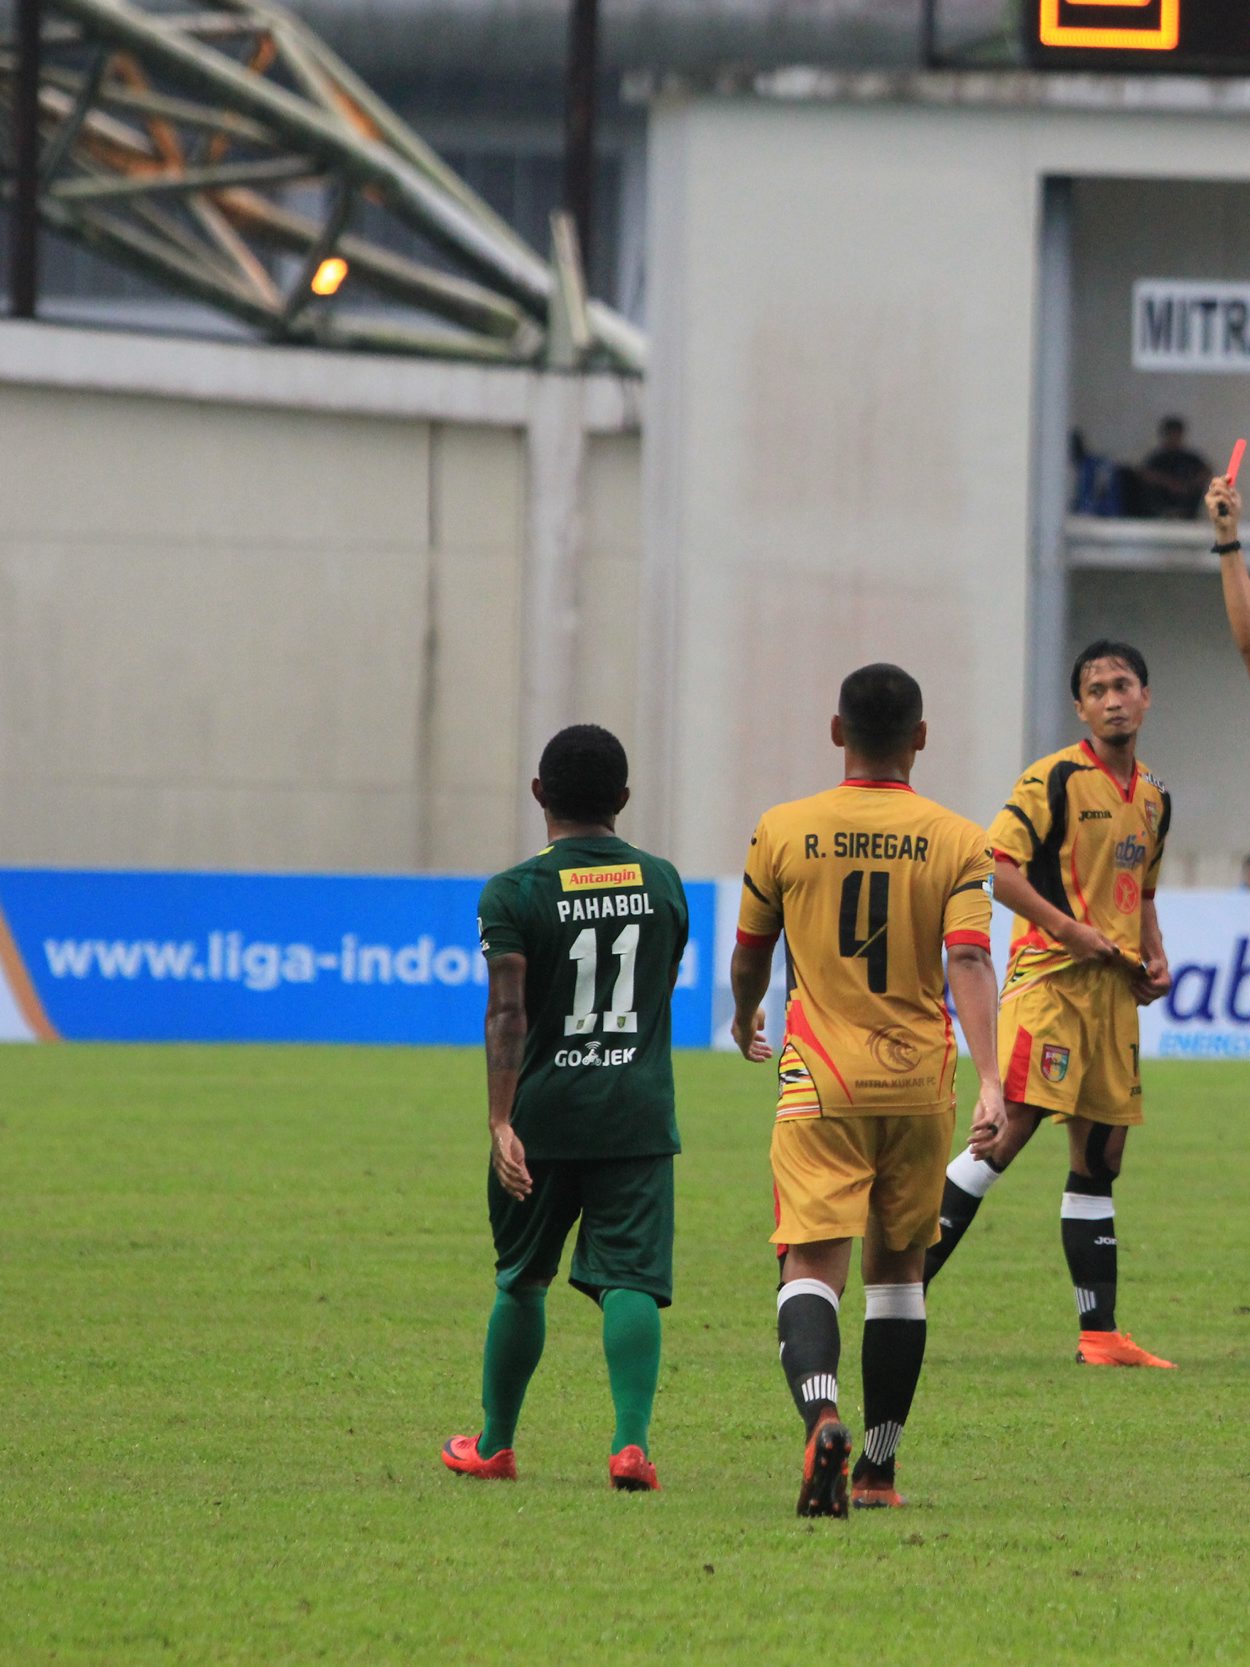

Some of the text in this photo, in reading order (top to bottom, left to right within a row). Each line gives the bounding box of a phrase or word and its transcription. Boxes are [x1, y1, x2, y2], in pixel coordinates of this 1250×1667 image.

[804, 831, 930, 863] R. SIREGAR
[568, 869, 636, 886] Antangin
[557, 892, 654, 923] PAHABOL
[838, 869, 890, 994] 4
[563, 923, 640, 1037] 11
